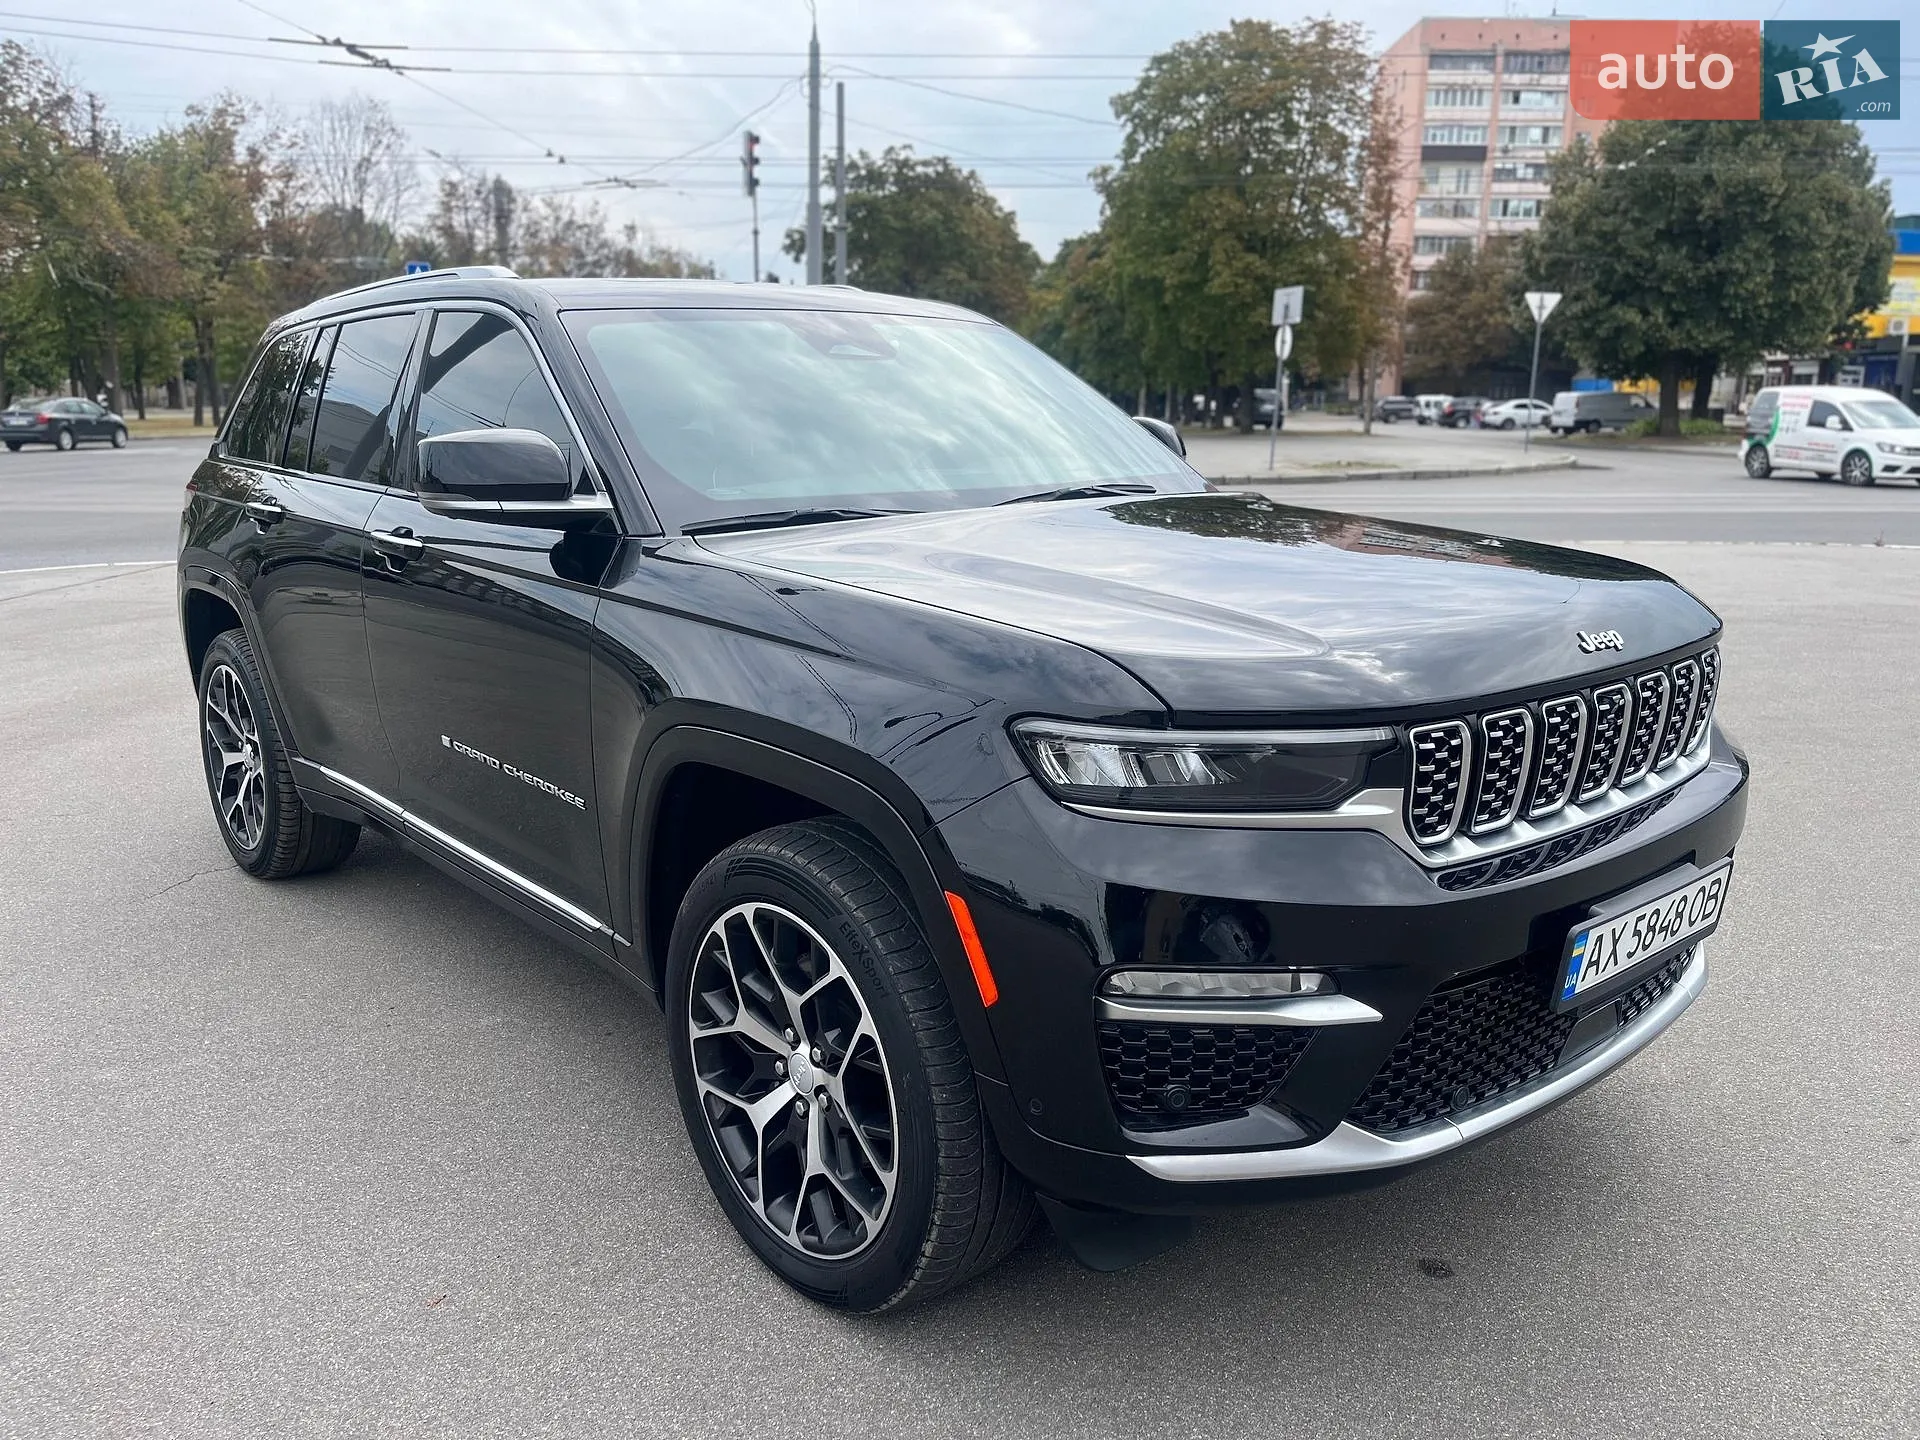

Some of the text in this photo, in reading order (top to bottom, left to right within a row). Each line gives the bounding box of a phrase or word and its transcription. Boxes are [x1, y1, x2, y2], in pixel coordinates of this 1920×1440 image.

[1576, 630, 1624, 654] Jeep
[452, 741, 586, 811] GRAND CHEROKEE
[1581, 877, 1722, 983] AX 5848 OB
[1564, 973, 1579, 989] UA
